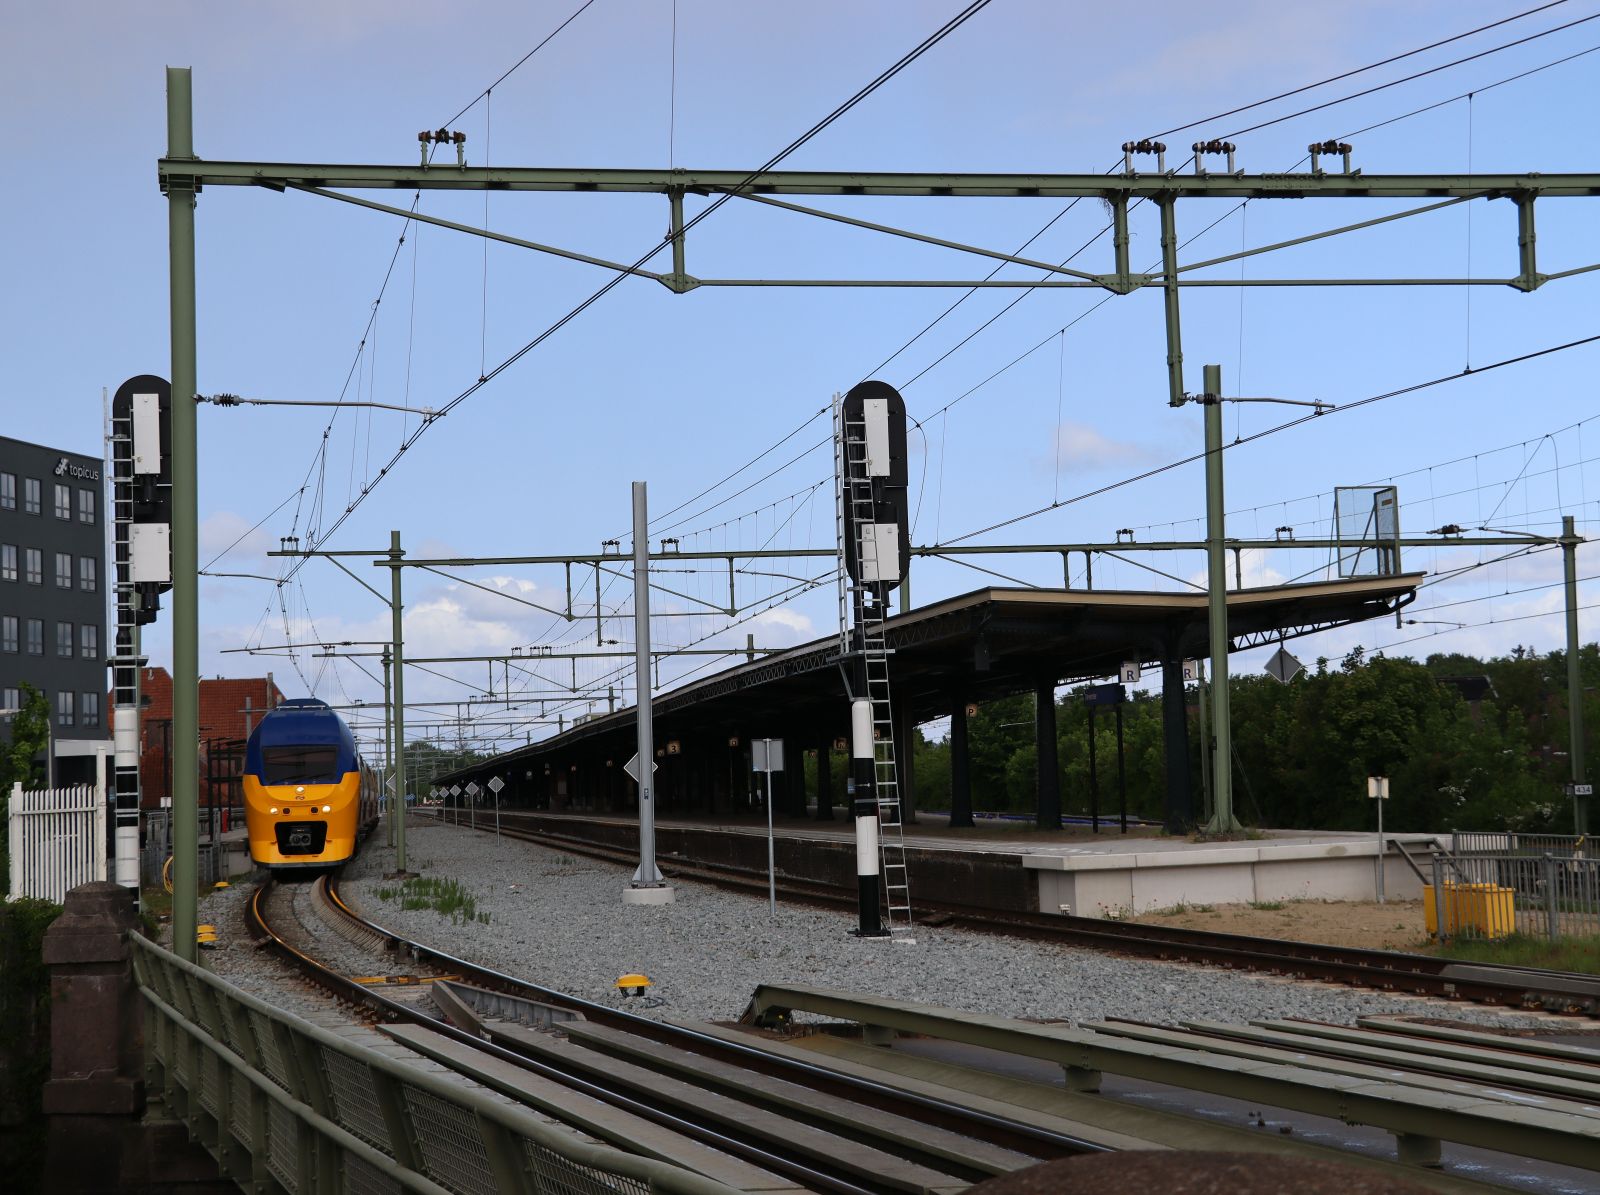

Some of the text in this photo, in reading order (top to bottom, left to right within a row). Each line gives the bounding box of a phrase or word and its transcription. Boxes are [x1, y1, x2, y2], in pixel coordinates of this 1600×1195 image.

[69, 464, 99, 480] topicus
[1126, 670, 1135, 681] R
[1184, 668, 1192, 679] R
[968, 708, 974, 717] P
[671, 745, 677, 754] 3
